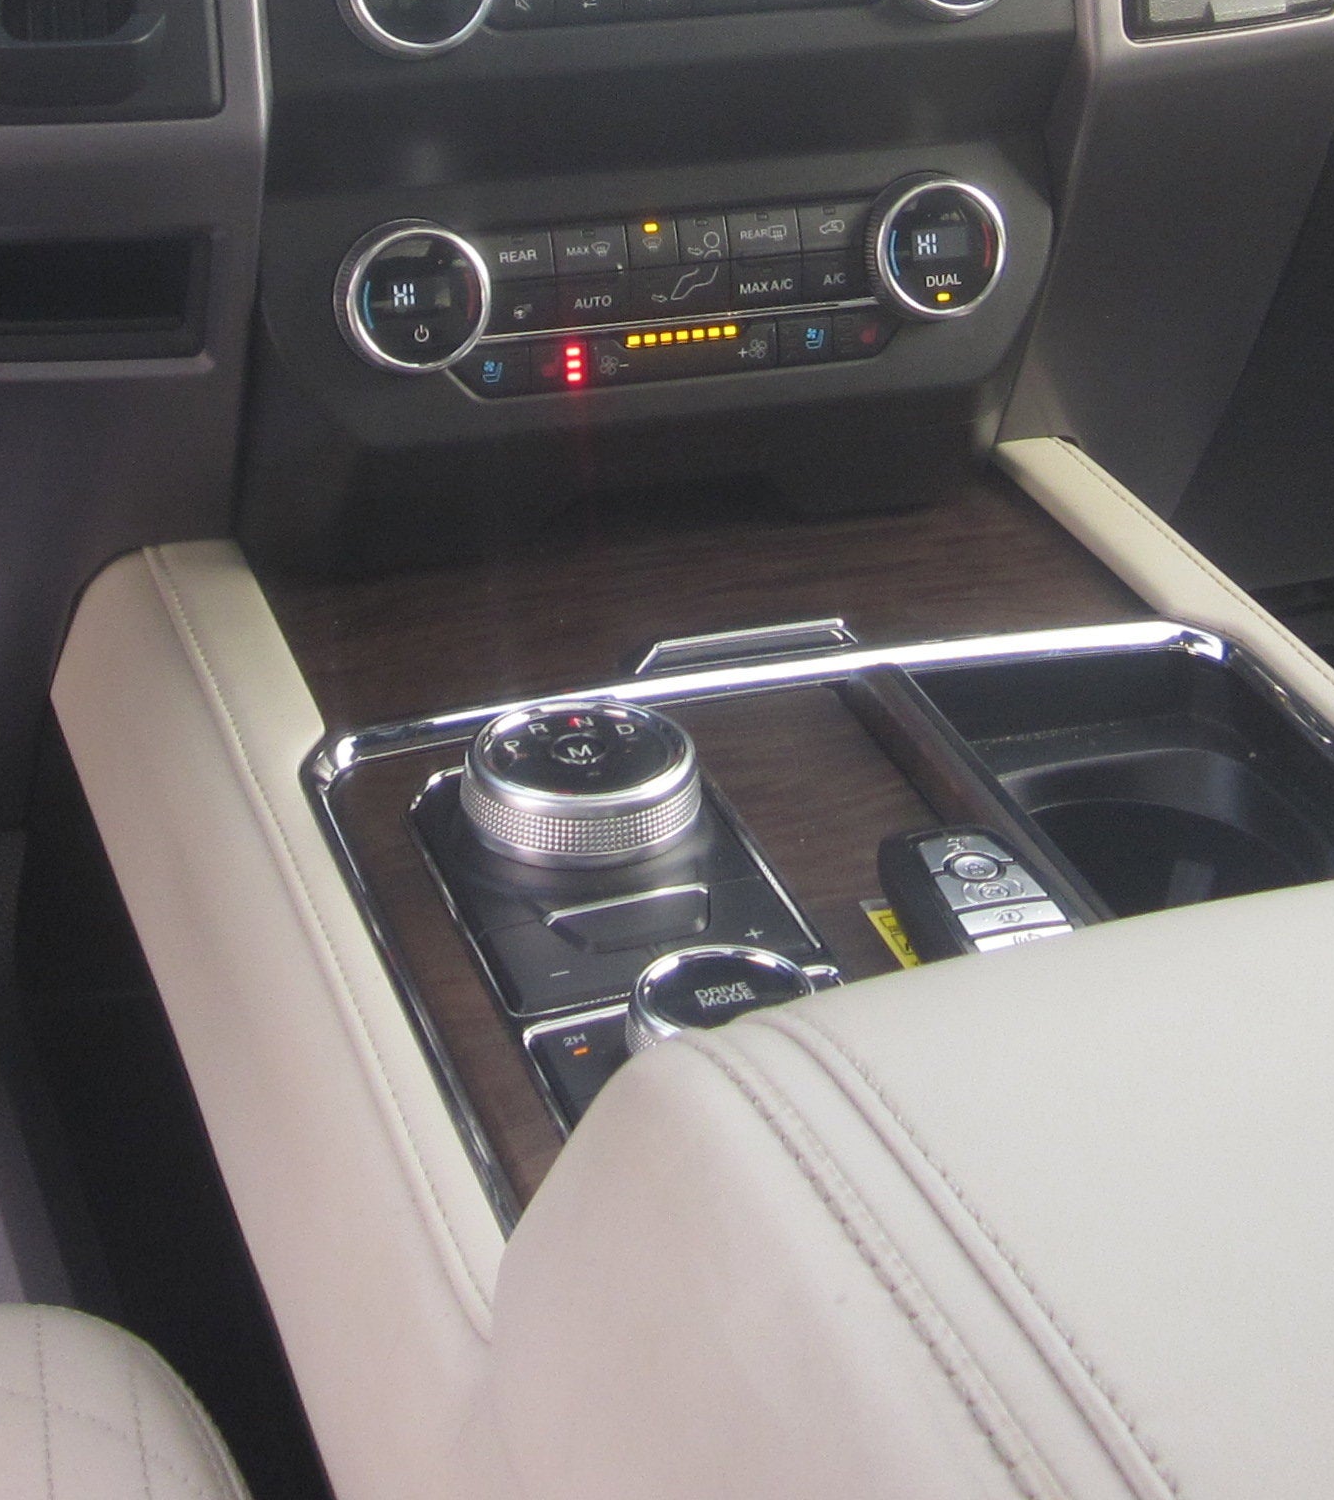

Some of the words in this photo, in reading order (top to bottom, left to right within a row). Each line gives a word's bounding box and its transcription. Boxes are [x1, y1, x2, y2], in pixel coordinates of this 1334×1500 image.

[739, 228, 768, 241] REAR
[566, 245, 590, 257] MAX
[916, 233, 937, 256] HI
[499, 248, 538, 264] REAR
[739, 281, 769, 295] MAX
[770, 277, 794, 291] A/C
[822, 272, 847, 286] A/C
[925, 273, 962, 288] DUAL
[393, 282, 415, 307] HI
[573, 294, 612, 310] AUTO
[527, 722, 549, 736] R
[575, 715, 595, 729] N
[615, 723, 635, 736] D
[503, 739, 520, 754] P
[567, 744, 593, 759] M
[693, 981, 749, 1000] DRIVE
[699, 988, 756, 1009] MODE
[562, 1032, 587, 1047] 2H
